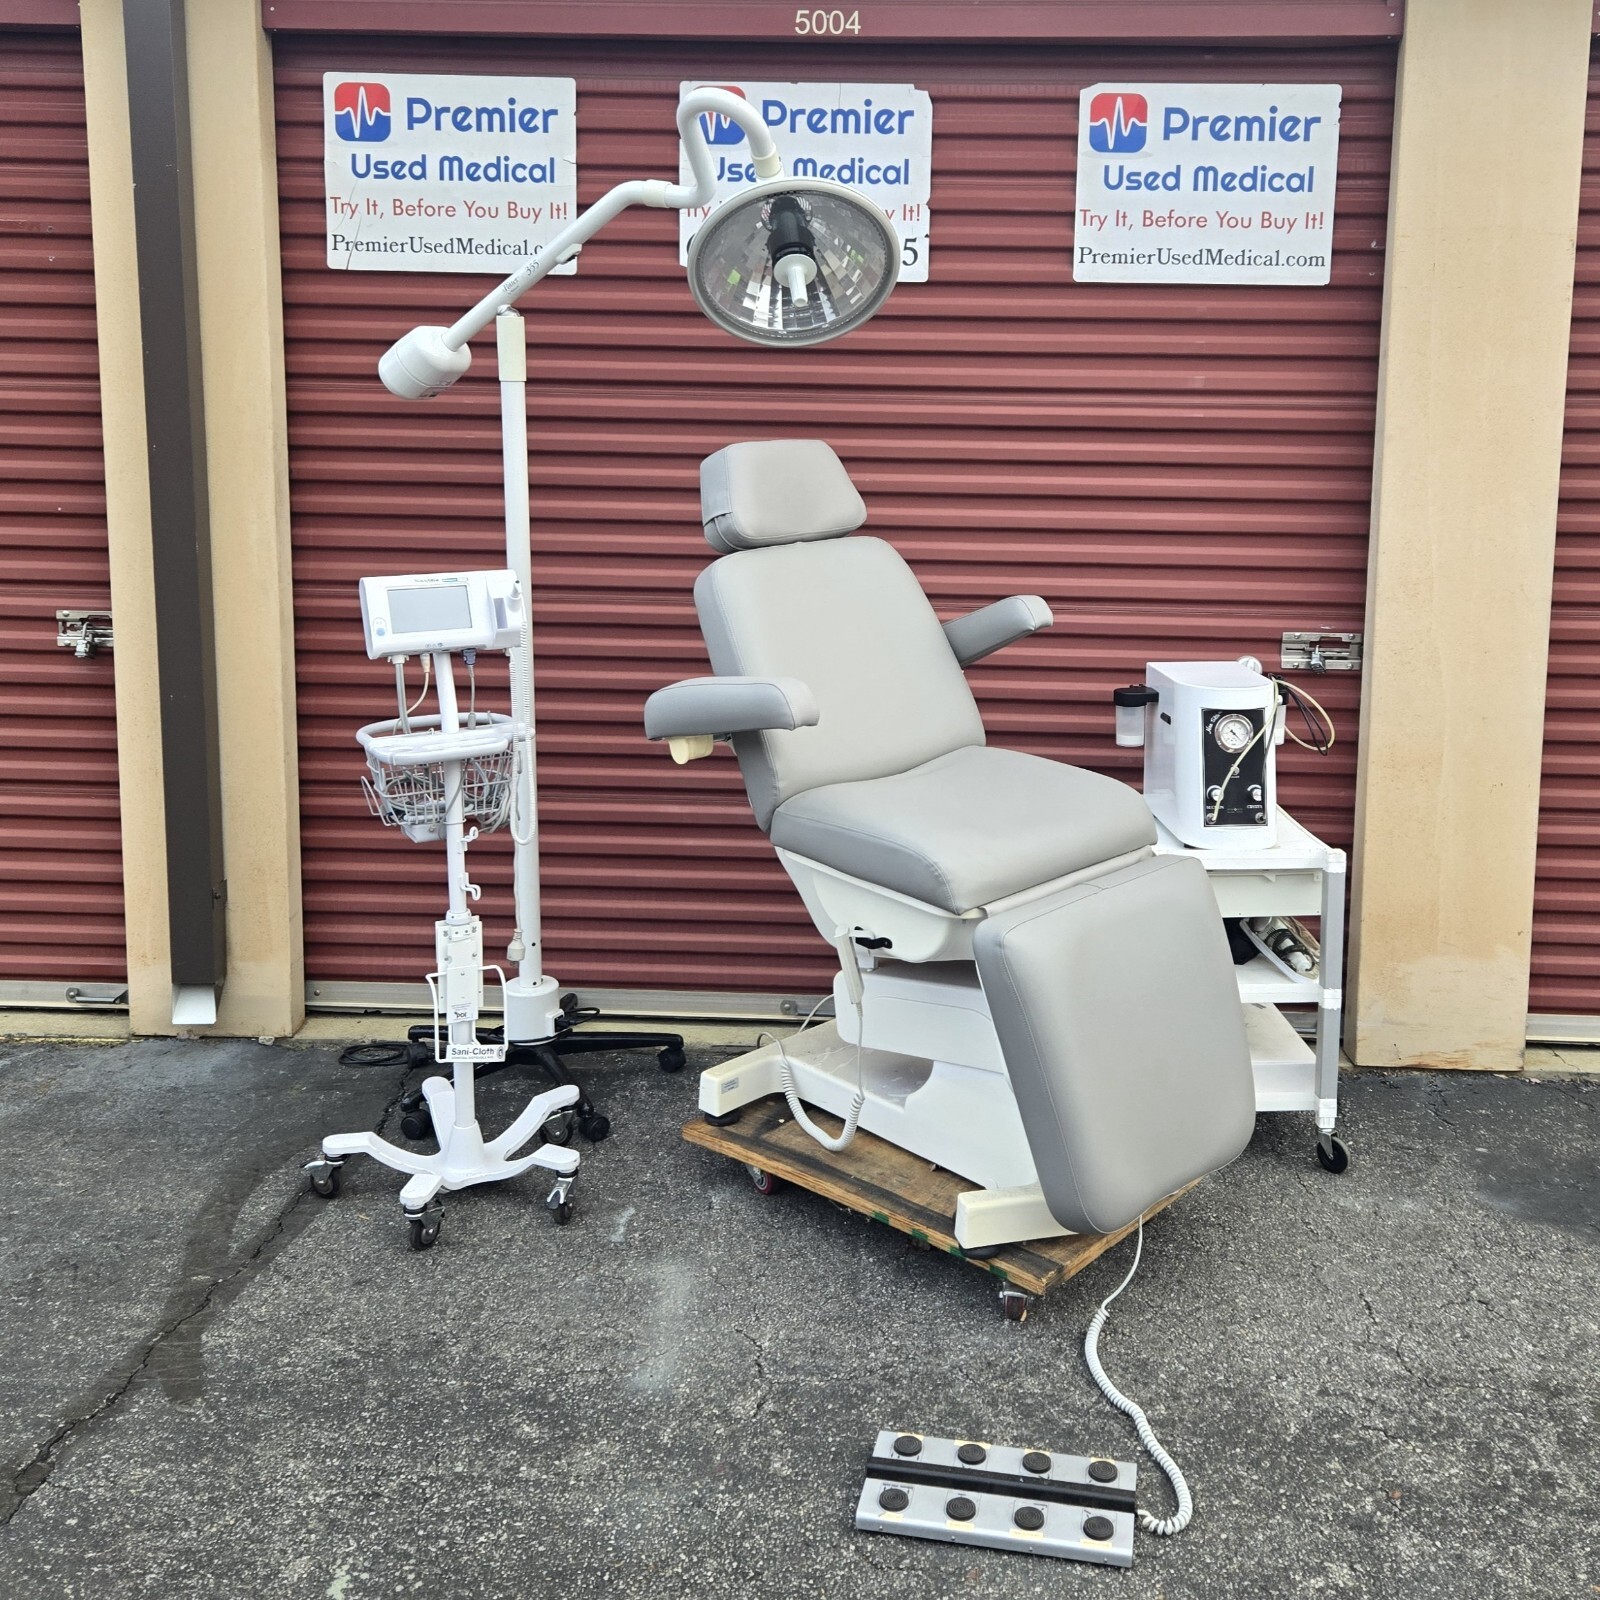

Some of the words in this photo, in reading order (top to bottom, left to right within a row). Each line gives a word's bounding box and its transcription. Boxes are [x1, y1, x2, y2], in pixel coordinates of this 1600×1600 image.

[795, 10, 861, 34] 5004
[406, 97, 559, 134] Premier
[761, 98, 915, 136] Premier
[1162, 105, 1322, 142] Premier
[351, 153, 427, 180] Used
[438, 155, 555, 184] Medical
[793, 157, 909, 185] Medical
[1103, 164, 1181, 192] Used
[1192, 164, 1314, 193] Medical
[329, 196, 359, 220] Try
[366, 198, 384, 219] It,
[393, 198, 456, 218] Before
[463, 200, 499, 219] You
[507, 201, 543, 224] Buy
[550, 202, 568, 220] It!
[902, 203, 920, 221] It!
[1079, 209, 1108, 232] Try
[1115, 209, 1133, 230] It,
[1142, 209, 1208, 228] Before
[1216, 210, 1252, 229] You
[1260, 211, 1298, 234] Buy
[1305, 212, 1324, 230] It!
[331, 233, 544, 256] PremierUsedMedical.c
[1078, 246, 1326, 267] PremierUsedMedical.com
[451, 1047, 494, 1056] Sani-Cloth
